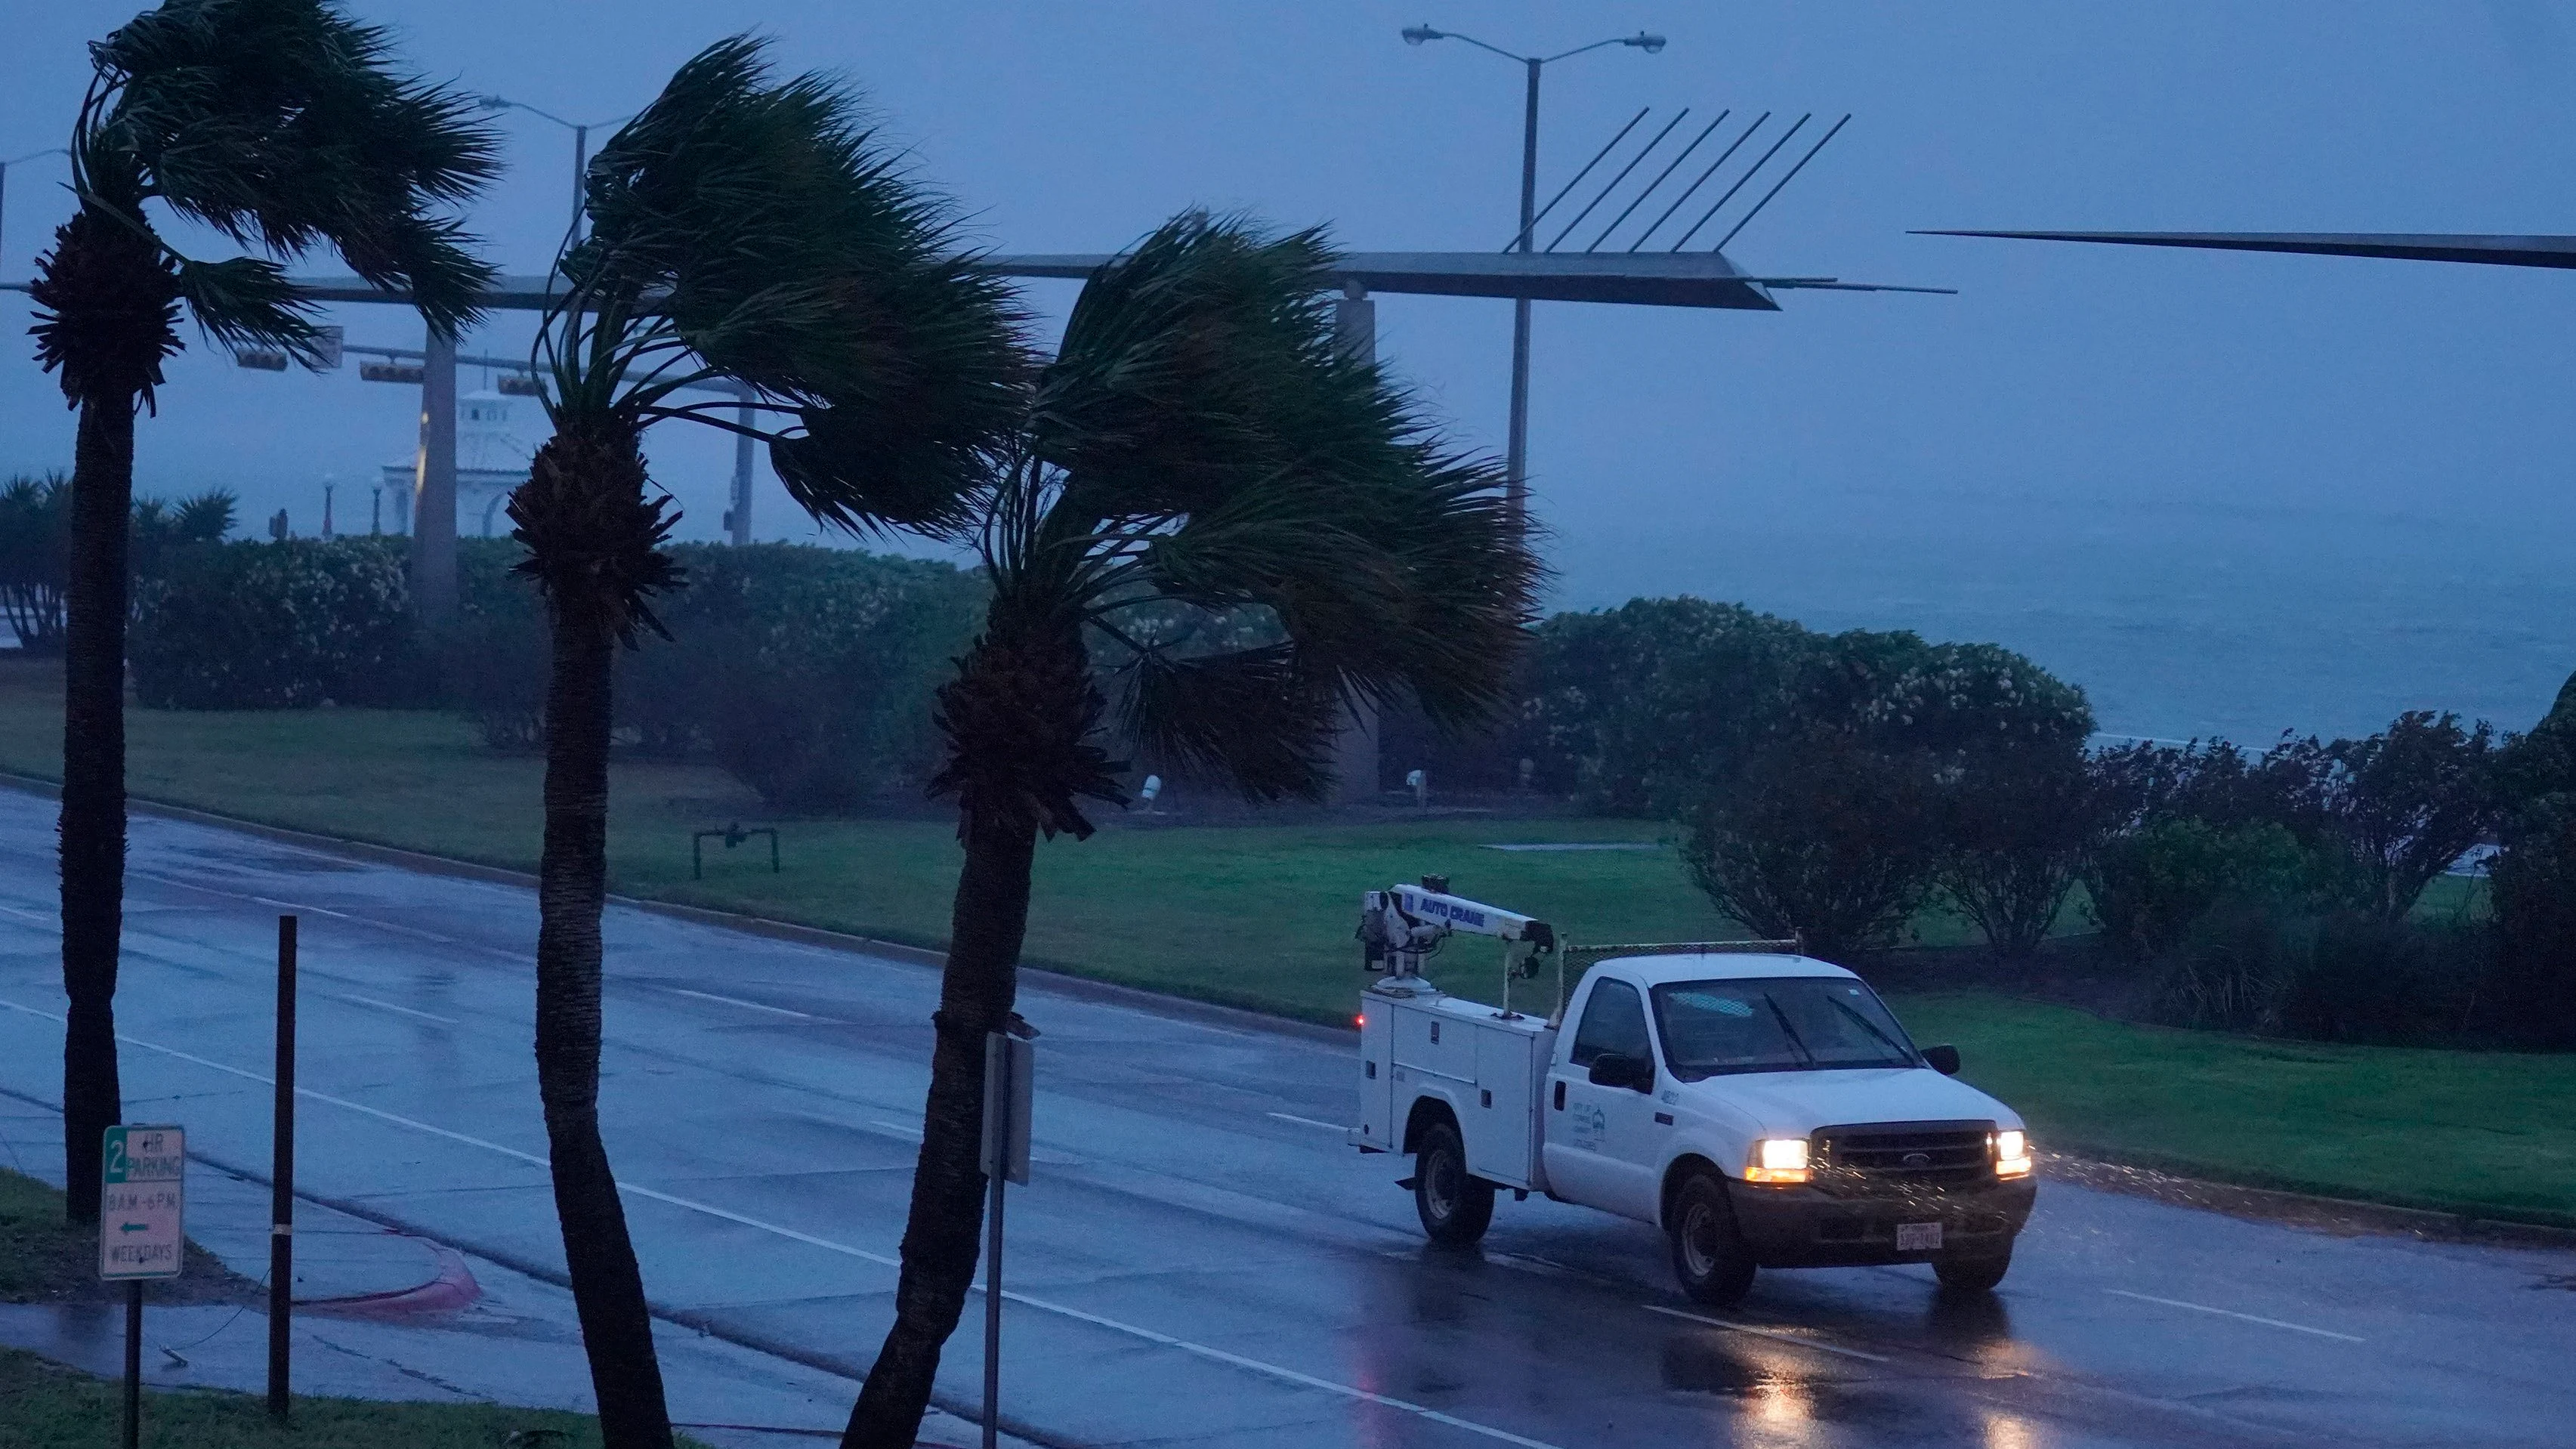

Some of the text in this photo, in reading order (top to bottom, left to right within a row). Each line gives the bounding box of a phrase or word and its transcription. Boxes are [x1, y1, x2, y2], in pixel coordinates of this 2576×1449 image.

[1420, 898, 1485, 927] AUTO CRANE
[110, 1133, 164, 1172] 2 HR
[127, 1156, 180, 1177] PARKING
[111, 1244, 172, 1263] WEEKDAYS
